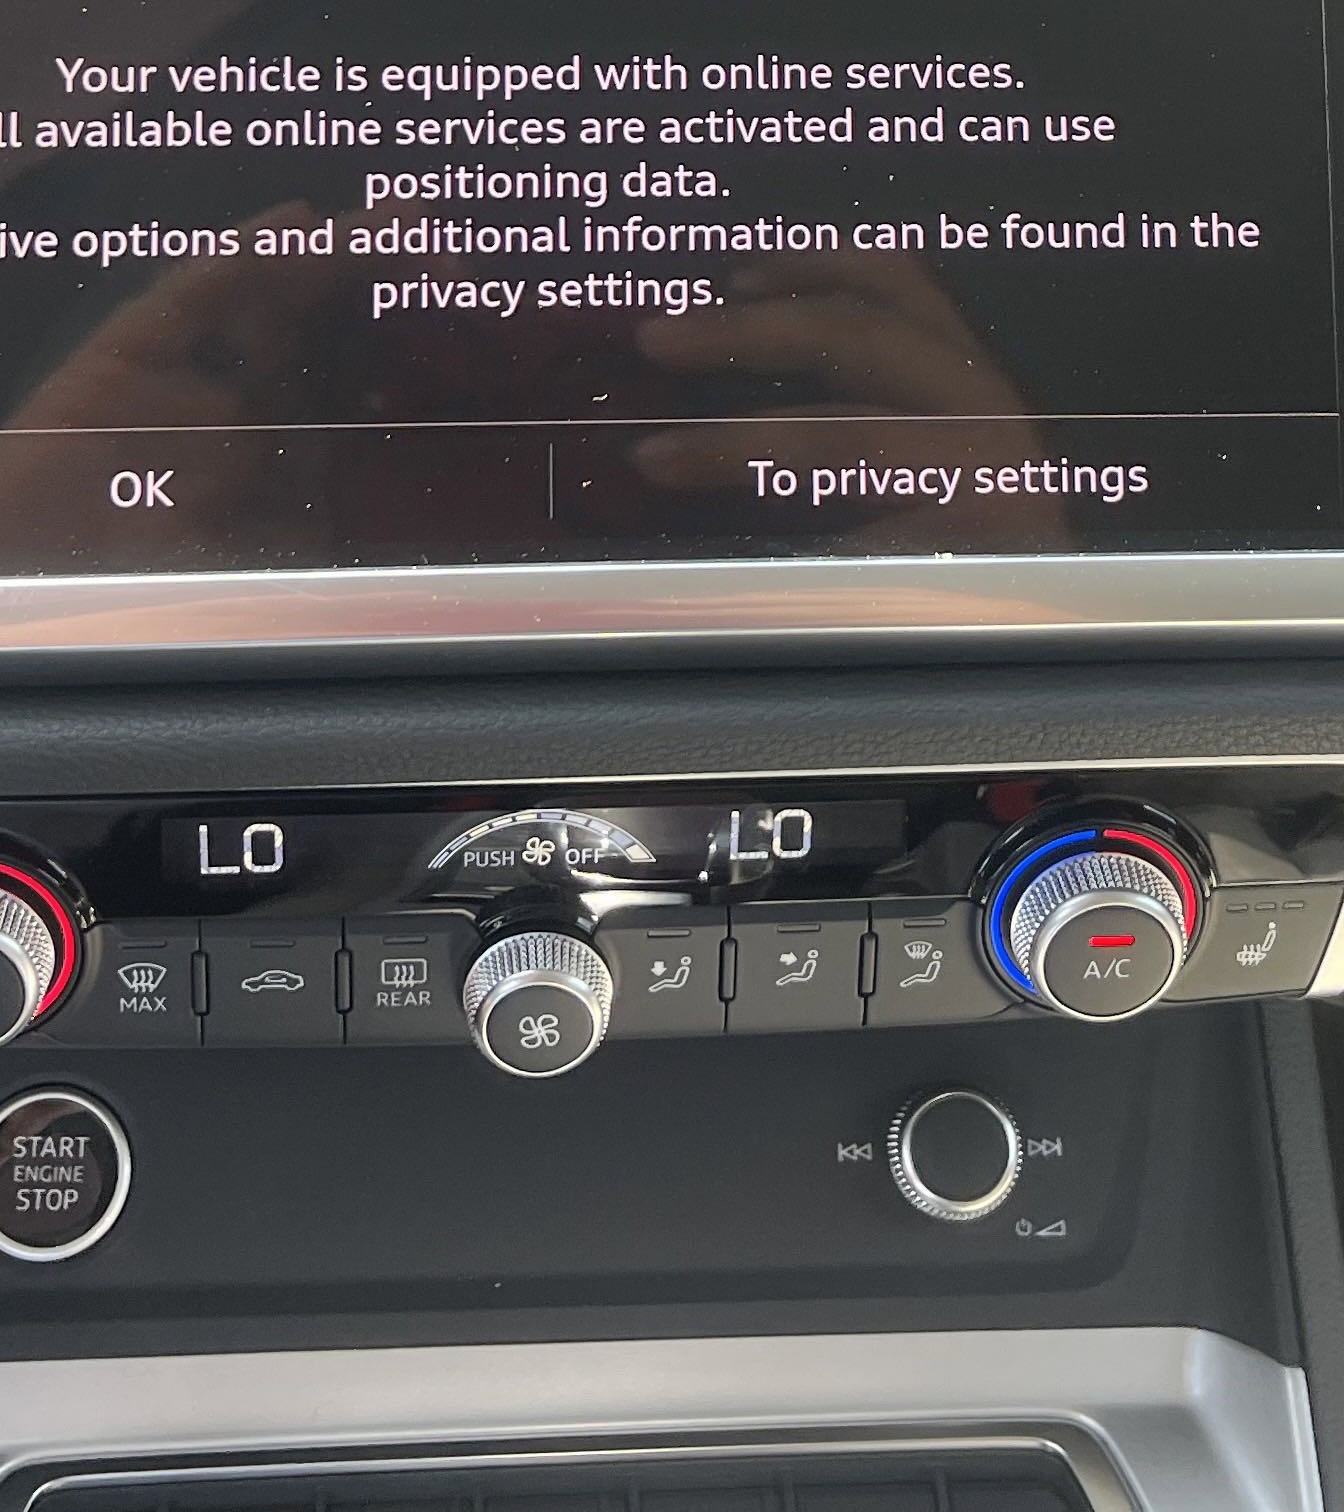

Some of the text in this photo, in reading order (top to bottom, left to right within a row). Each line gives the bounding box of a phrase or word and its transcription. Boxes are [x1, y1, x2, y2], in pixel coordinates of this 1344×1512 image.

[55, 53, 1024, 101] Your vehicle is equipped with online services.
[35, 110, 232, 148] available
[246, 109, 382, 146] online
[395, 109, 566, 145] services
[579, 117, 645, 144] are
[659, 107, 853, 144] activated
[868, 106, 944, 143] and
[958, 116, 1029, 142] can
[1045, 115, 1116, 142] use
[365, 161, 730, 210] positioning data.
[72, 221, 240, 268] options
[254, 218, 333, 256] and
[349, 216, 571, 255] additional
[583, 214, 838, 252] information
[852, 221, 924, 250] can
[940, 213, 989, 249] be
[1000, 212, 1125, 249] found
[1141, 212, 1177, 248] in
[1189, 211, 1260, 248] the
[372, 270, 725, 319] privacy settings.
[109, 469, 176, 509] OK
[747, 456, 1149, 506] To privacy settings
[198, 822, 285, 876] LO
[729, 808, 813, 861] LO
[463, 847, 605, 868] PUSH OFF
[1082, 957, 1132, 983] A/C
[119, 995, 168, 1013] MAX
[376, 990, 431, 1008] REAR
[12, 1135, 89, 1159] START
[12, 1164, 84, 1184] ENGINE
[14, 1187, 80, 1212] STOP
